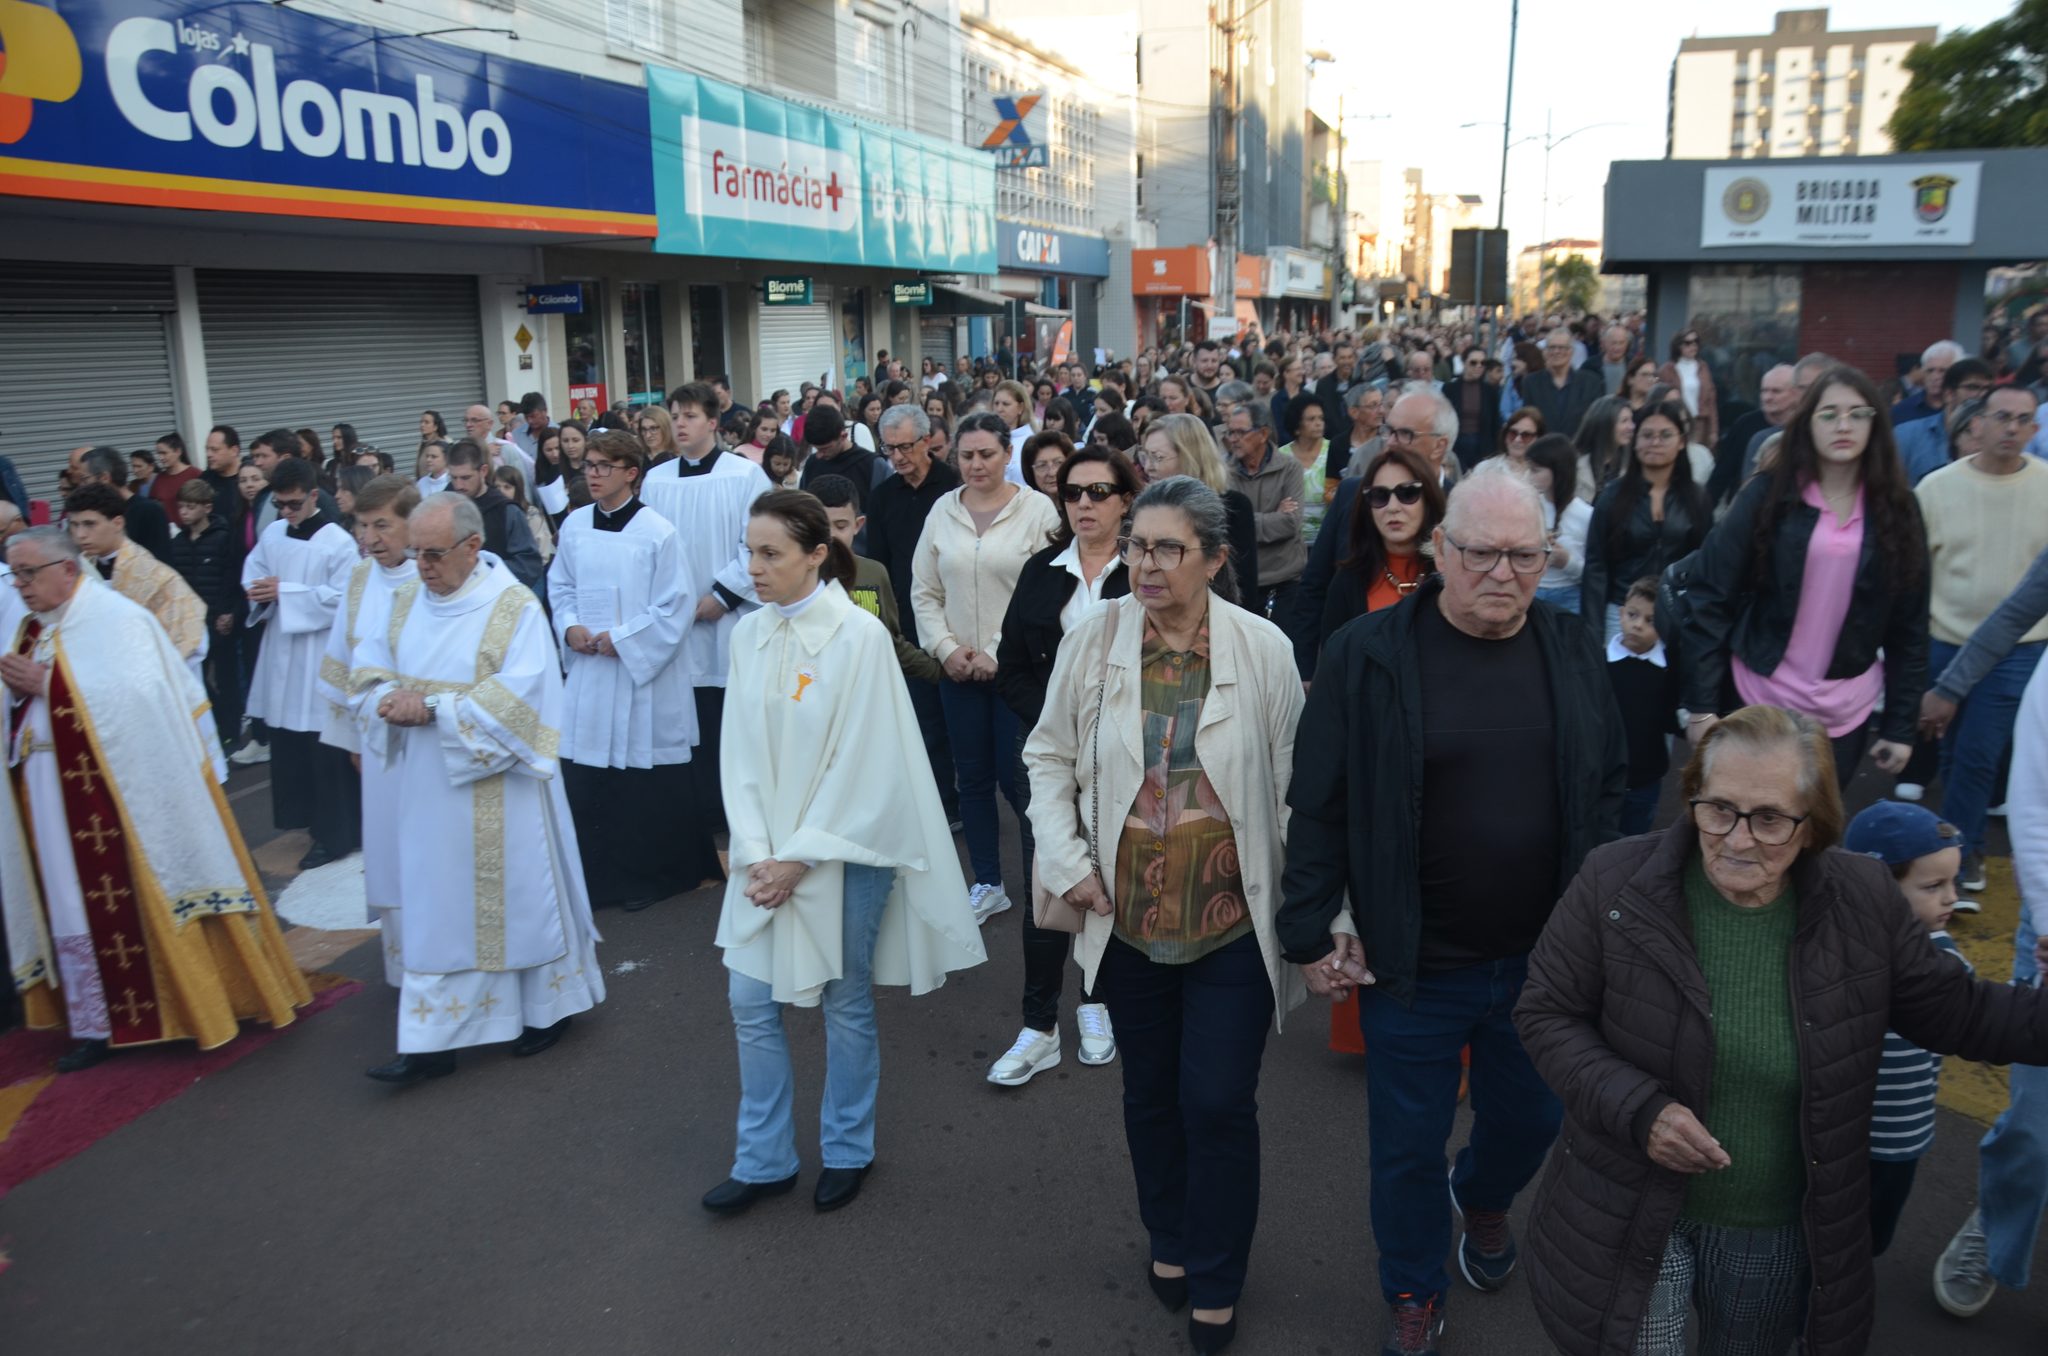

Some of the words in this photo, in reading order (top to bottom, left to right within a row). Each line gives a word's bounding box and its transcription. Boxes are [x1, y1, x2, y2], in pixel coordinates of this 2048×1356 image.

[177, 18, 220, 51] lojas
[105, 16, 512, 176] Colombo
[994, 147, 1043, 165] AIXA
[1796, 179, 1880, 200] BRIGADA
[1795, 203, 1877, 225] MILITAR
[1017, 230, 1060, 264] CAIXA
[538, 294, 578, 305] Colombo
